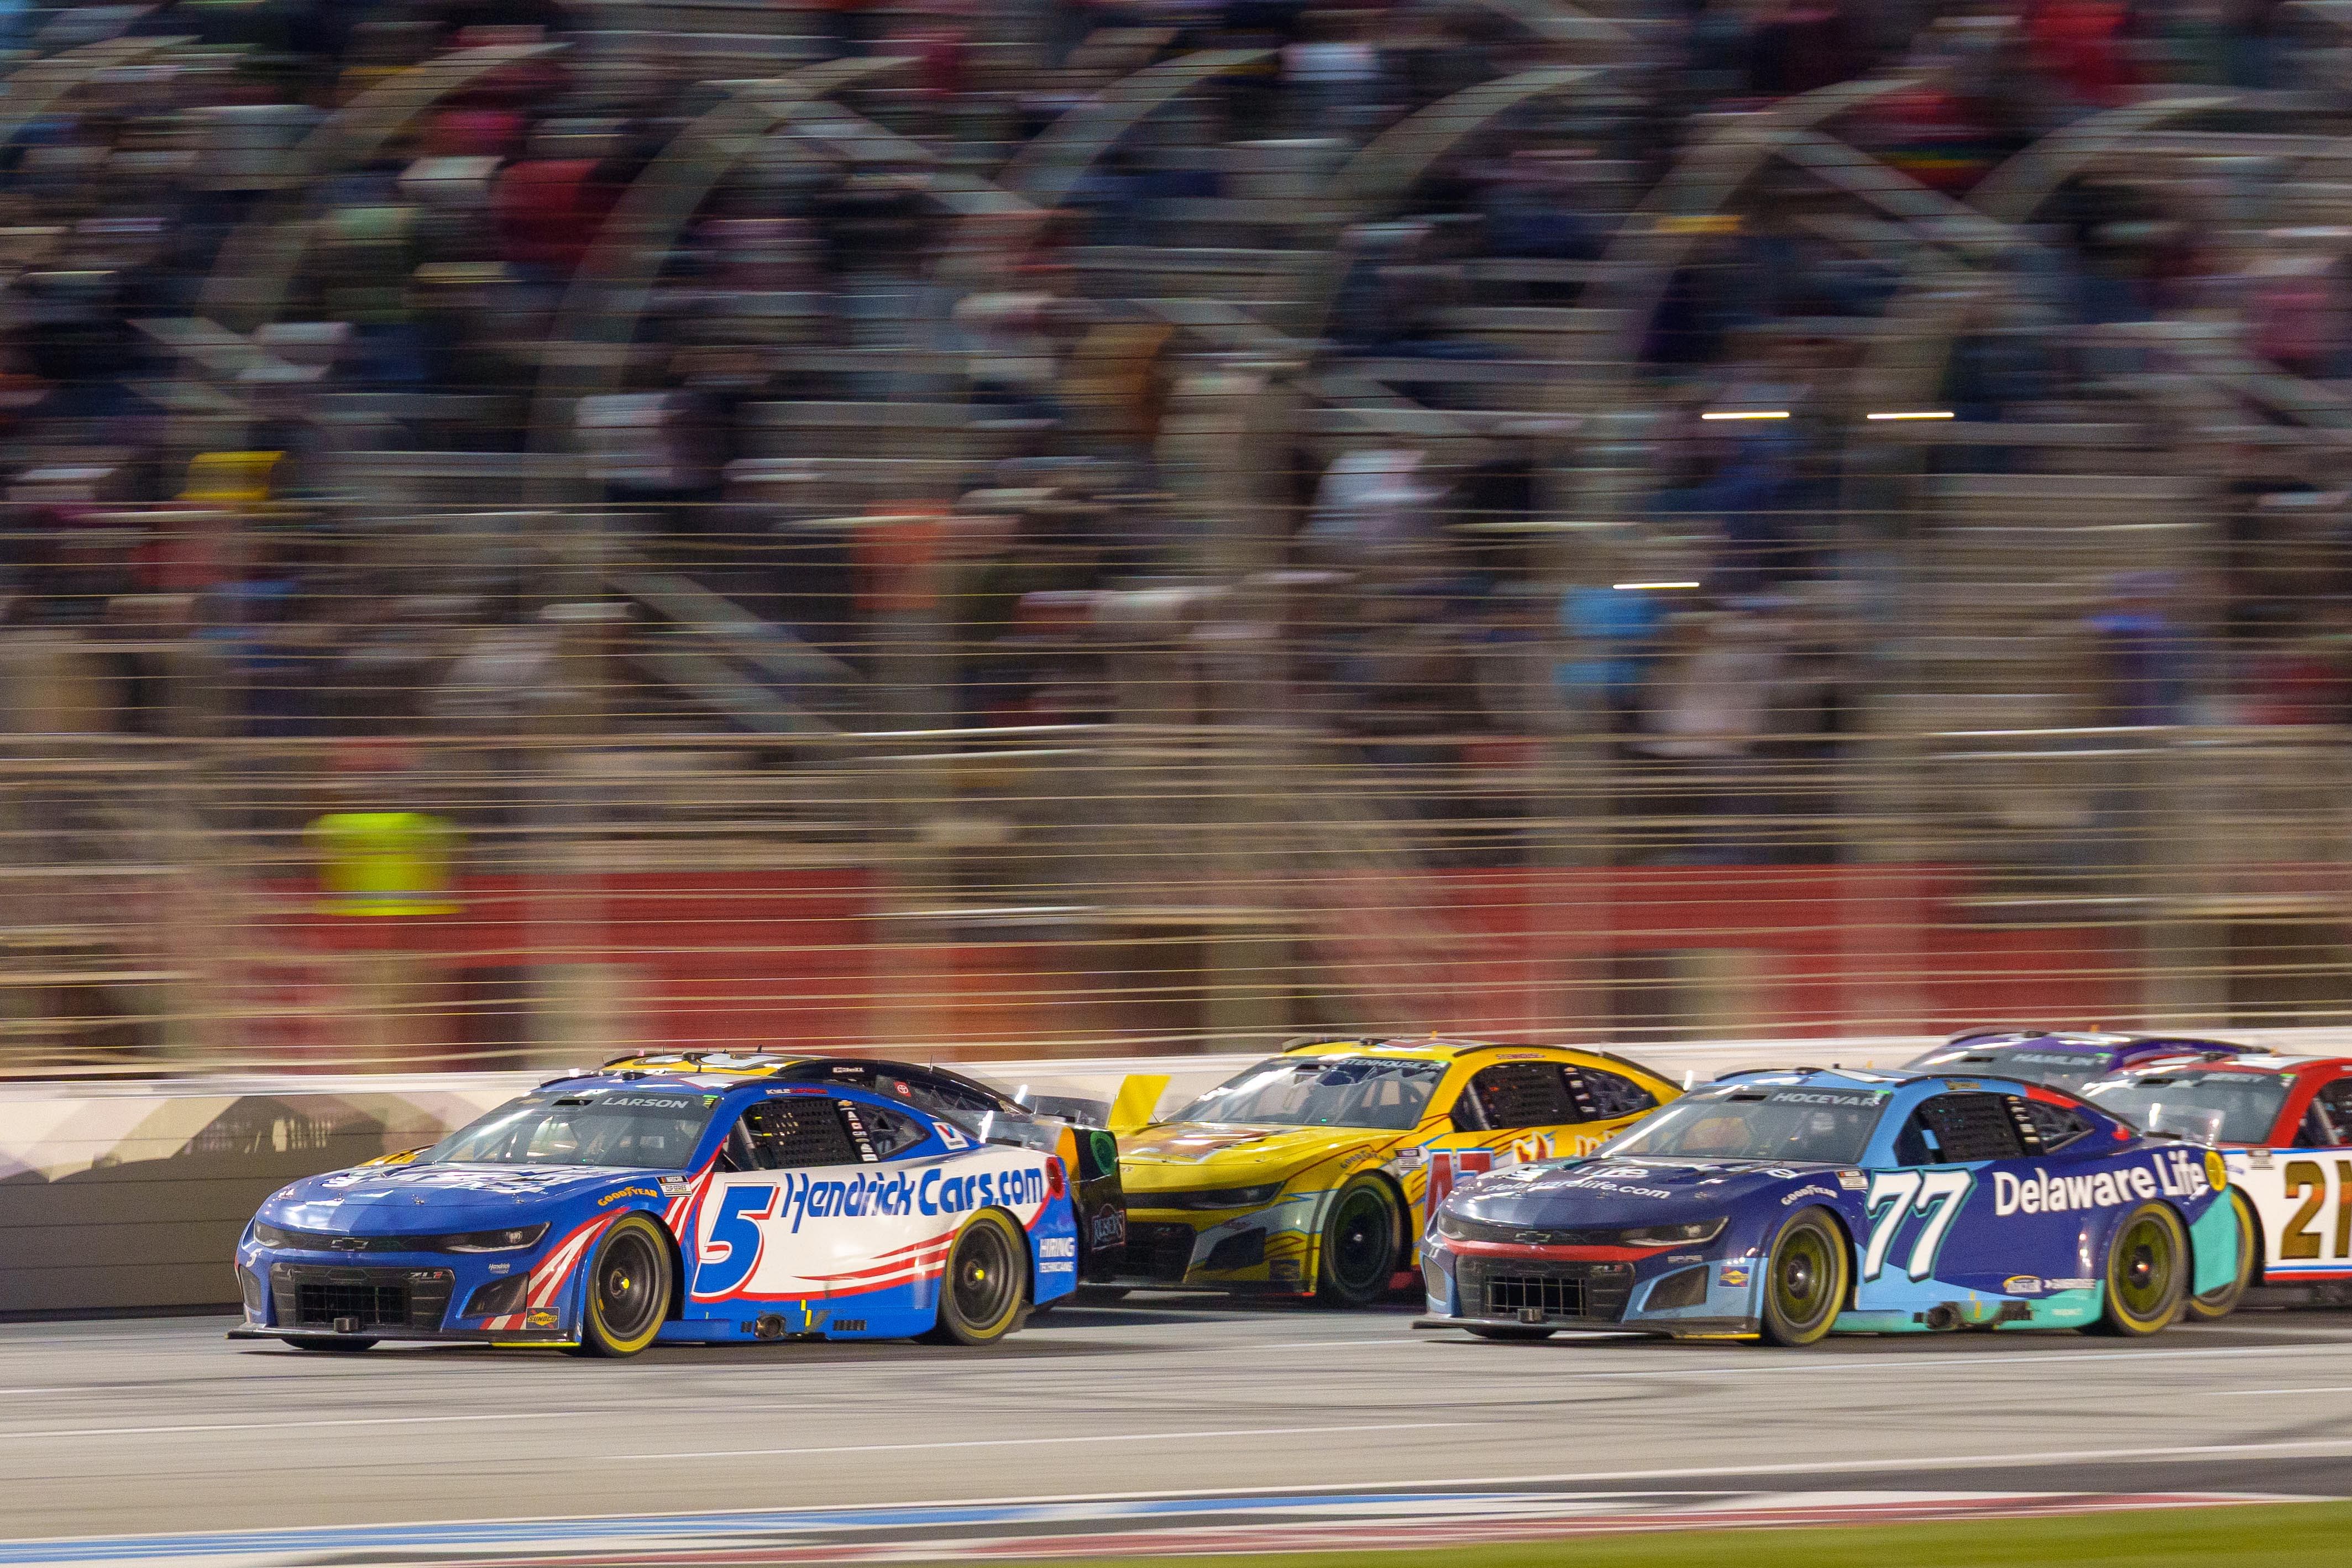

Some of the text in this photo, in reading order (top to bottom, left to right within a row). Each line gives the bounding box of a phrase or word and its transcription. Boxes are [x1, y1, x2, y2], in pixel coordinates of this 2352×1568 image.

[602, 1098, 689, 1108] LARSON
[1772, 1093, 1877, 1106] HOCEVAR
[1993, 1150, 2206, 1216] Delaware Life
[598, 1186, 658, 1206] GOODYEAR
[1780, 1185, 1838, 1205] GOODYEAR
[1865, 1167, 1977, 1282] 77
[691, 1182, 780, 1303] 5
[245, 1248, 263, 1267] 5
